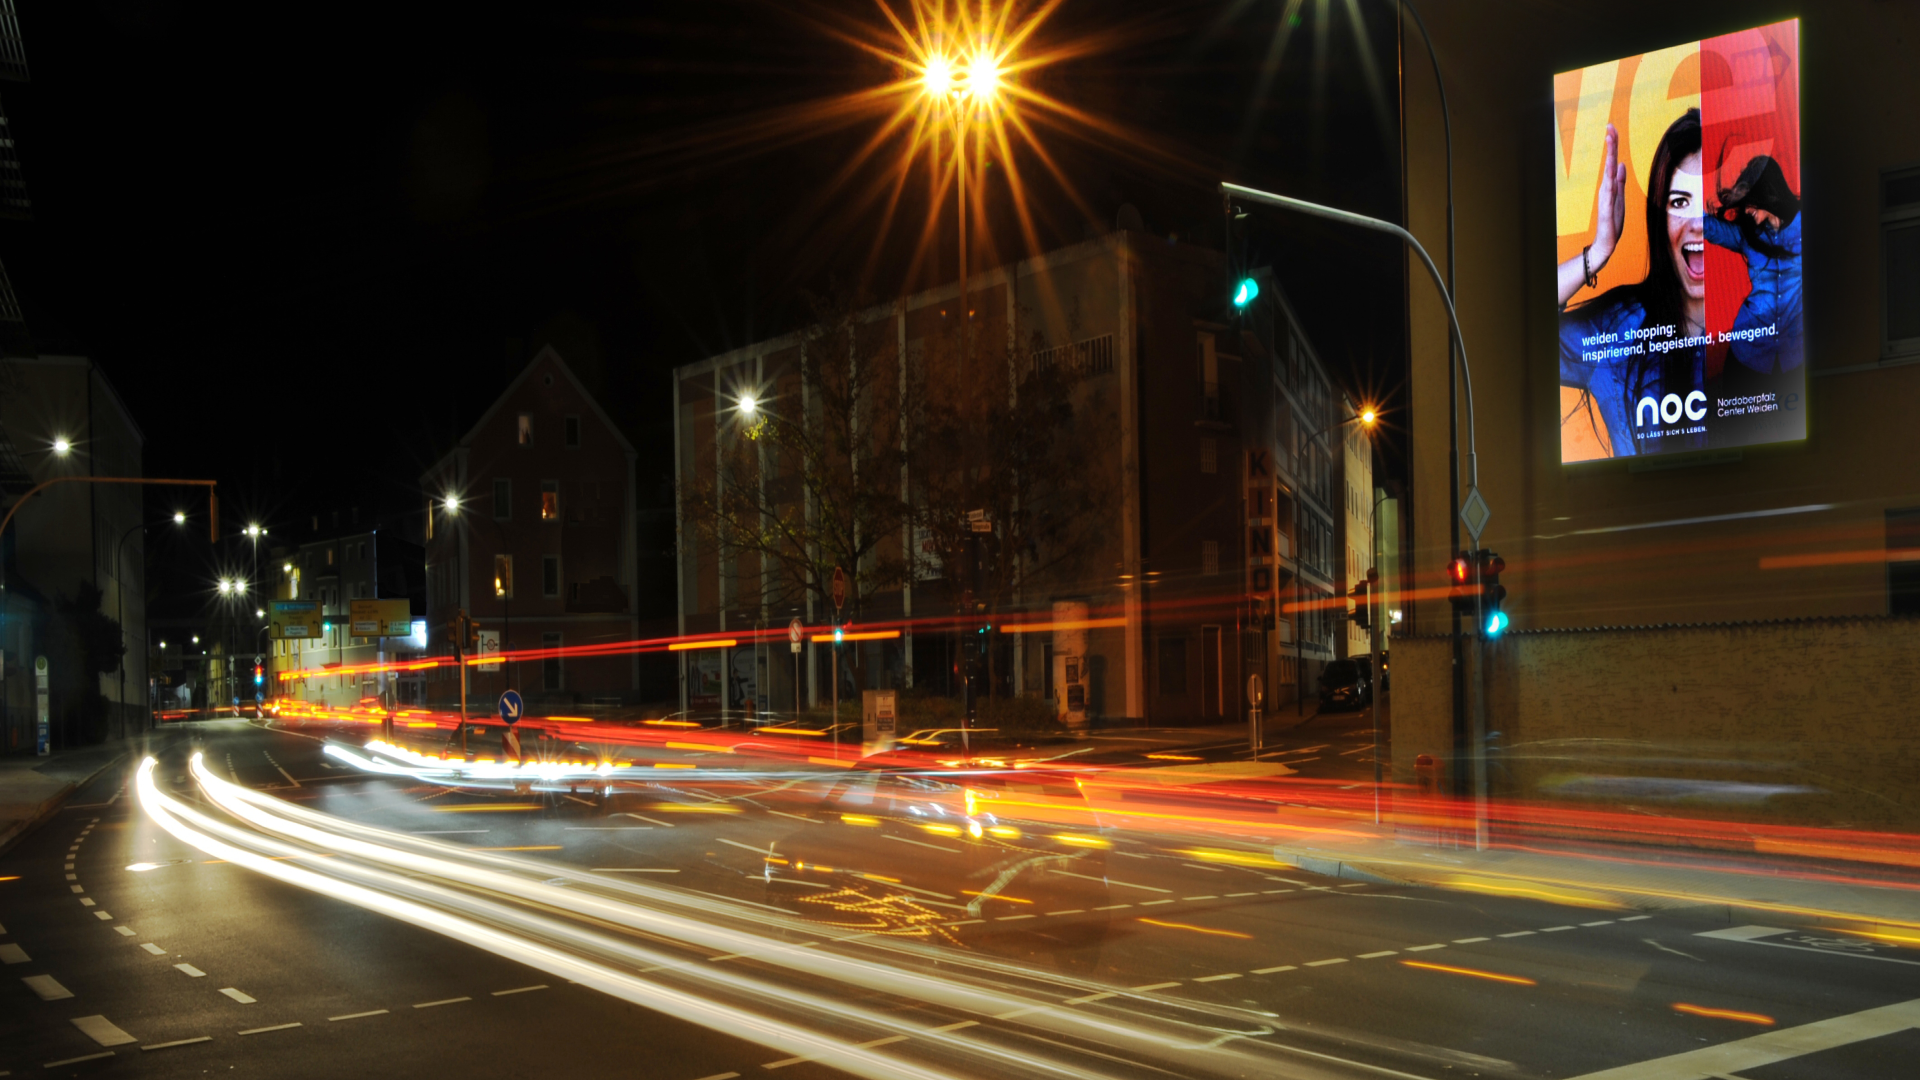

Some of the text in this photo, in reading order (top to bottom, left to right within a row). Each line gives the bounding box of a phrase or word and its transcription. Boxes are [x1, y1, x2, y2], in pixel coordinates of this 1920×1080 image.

[1582, 323, 1779, 363] inspirierend, begeisternd, bewegend.
[1636, 390, 1707, 427] noc
[1717, 392, 1776, 408] Nordoberpfalz
[1717, 403, 1778, 418] Center Weiden
[1636, 432, 1645, 440] SO
[1686, 425, 1708, 434] LEBEN.
[1250, 451, 1270, 592] KINO
